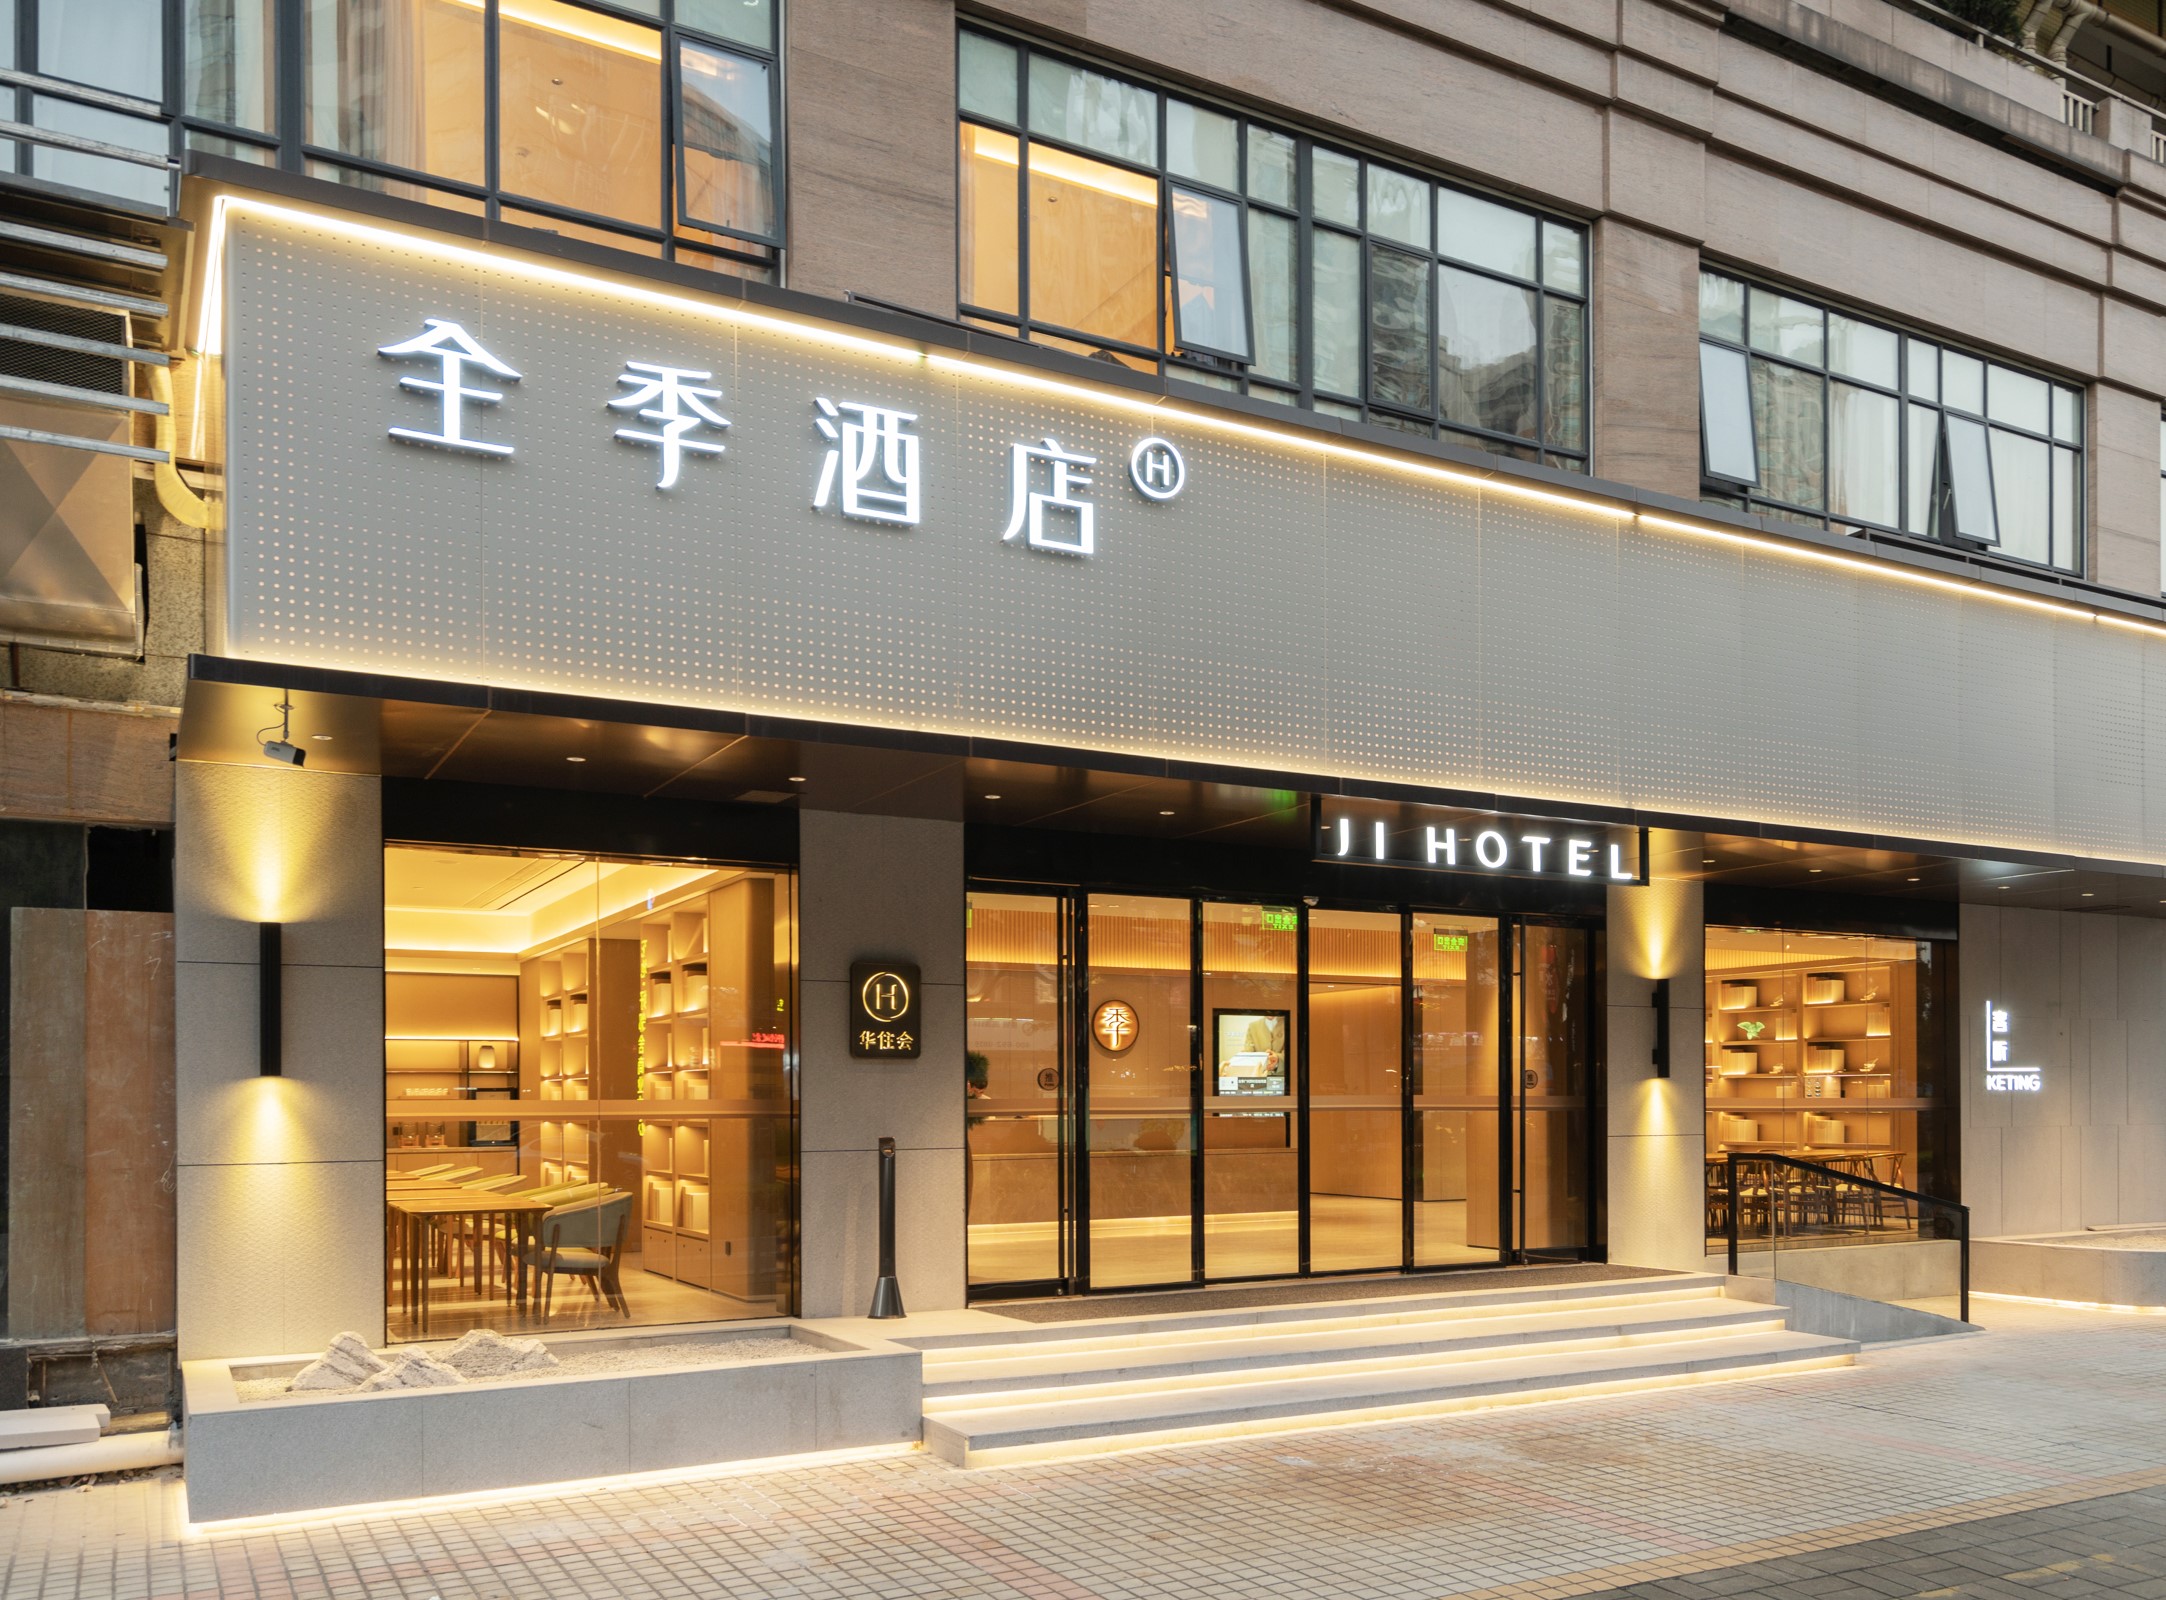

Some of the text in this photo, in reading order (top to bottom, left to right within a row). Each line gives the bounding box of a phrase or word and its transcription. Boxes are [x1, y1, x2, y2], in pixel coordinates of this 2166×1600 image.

[377, 318, 1098, 555] 全季酒店
[1337, 818, 1634, 880] JI HOTEL
[859, 1030, 914, 1051] 华住会
[1101, 1006, 1132, 1049] 季
[1986, 1074, 2041, 1092] KETING
